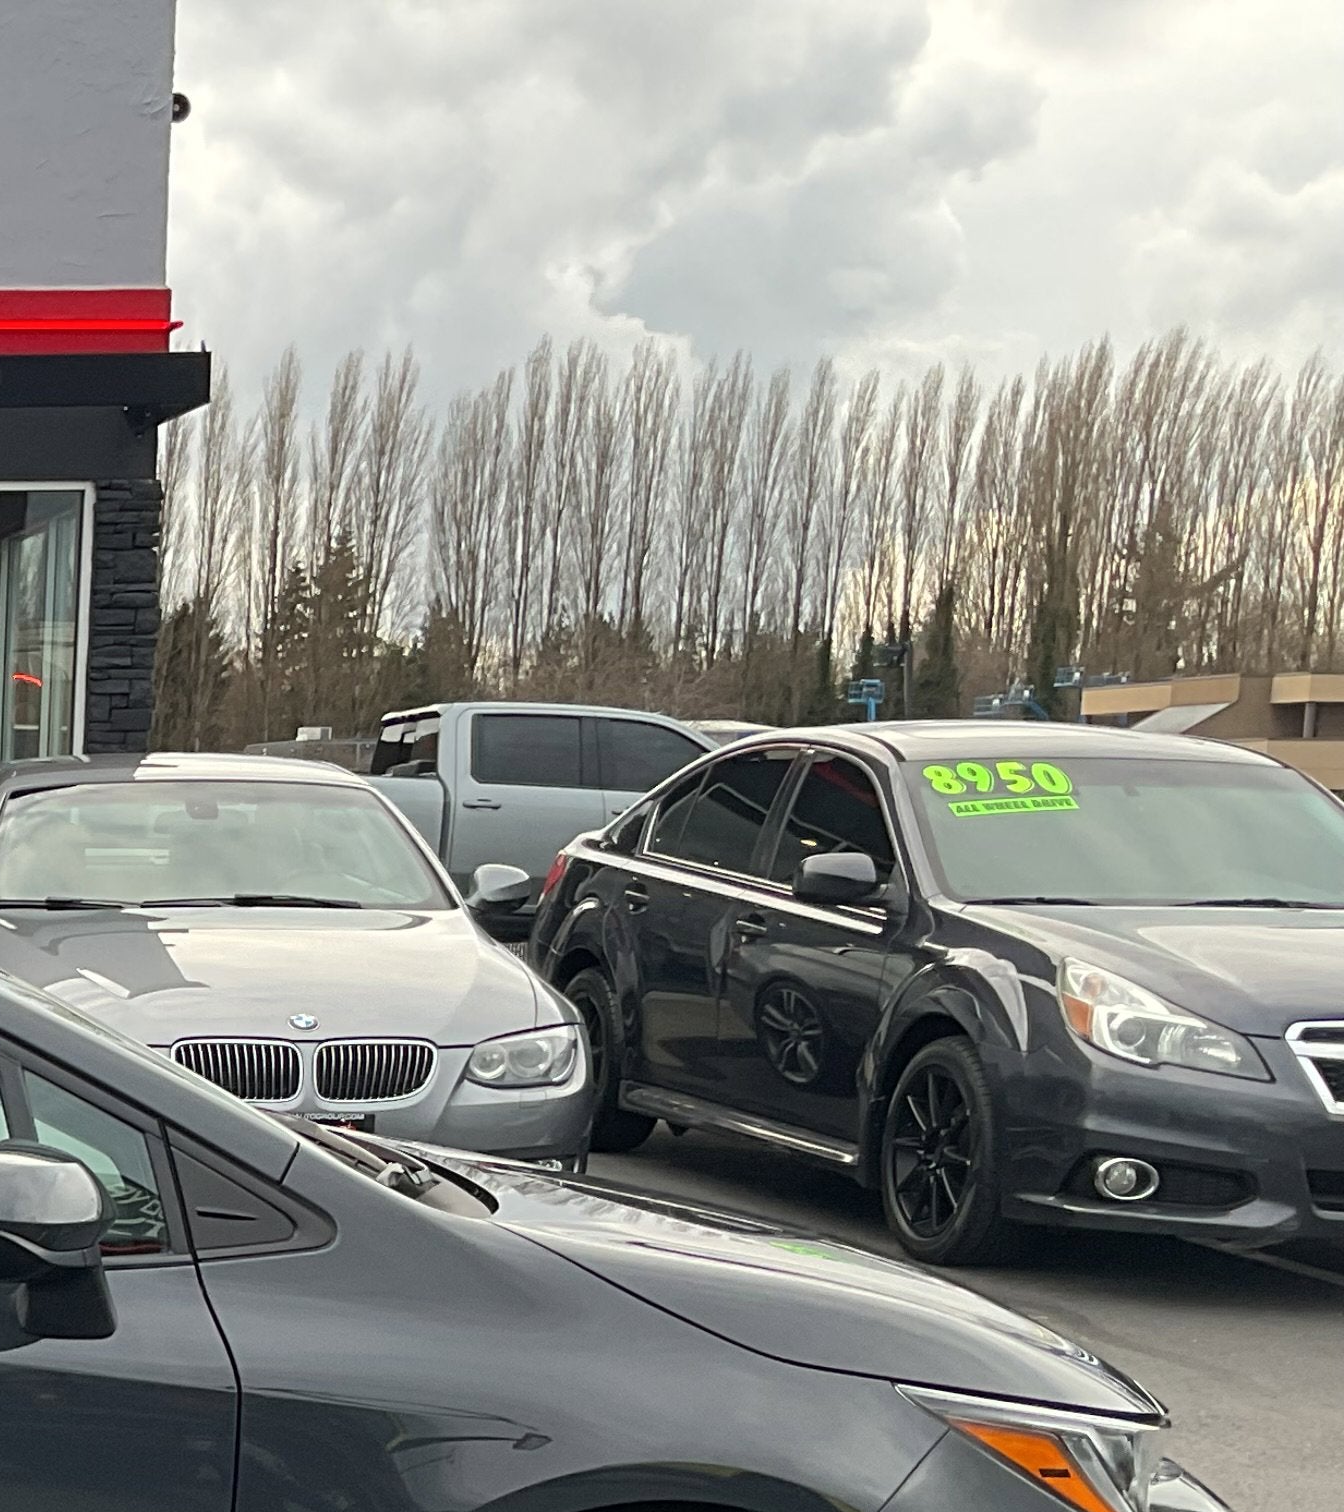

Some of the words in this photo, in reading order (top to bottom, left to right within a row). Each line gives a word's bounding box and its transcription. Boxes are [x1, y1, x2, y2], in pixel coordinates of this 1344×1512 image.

[922, 760, 1073, 796] 8950
[955, 804, 981, 814] ALL
[982, 801, 1029, 812] WHEEL
[1031, 797, 1074, 809] DRIVE
